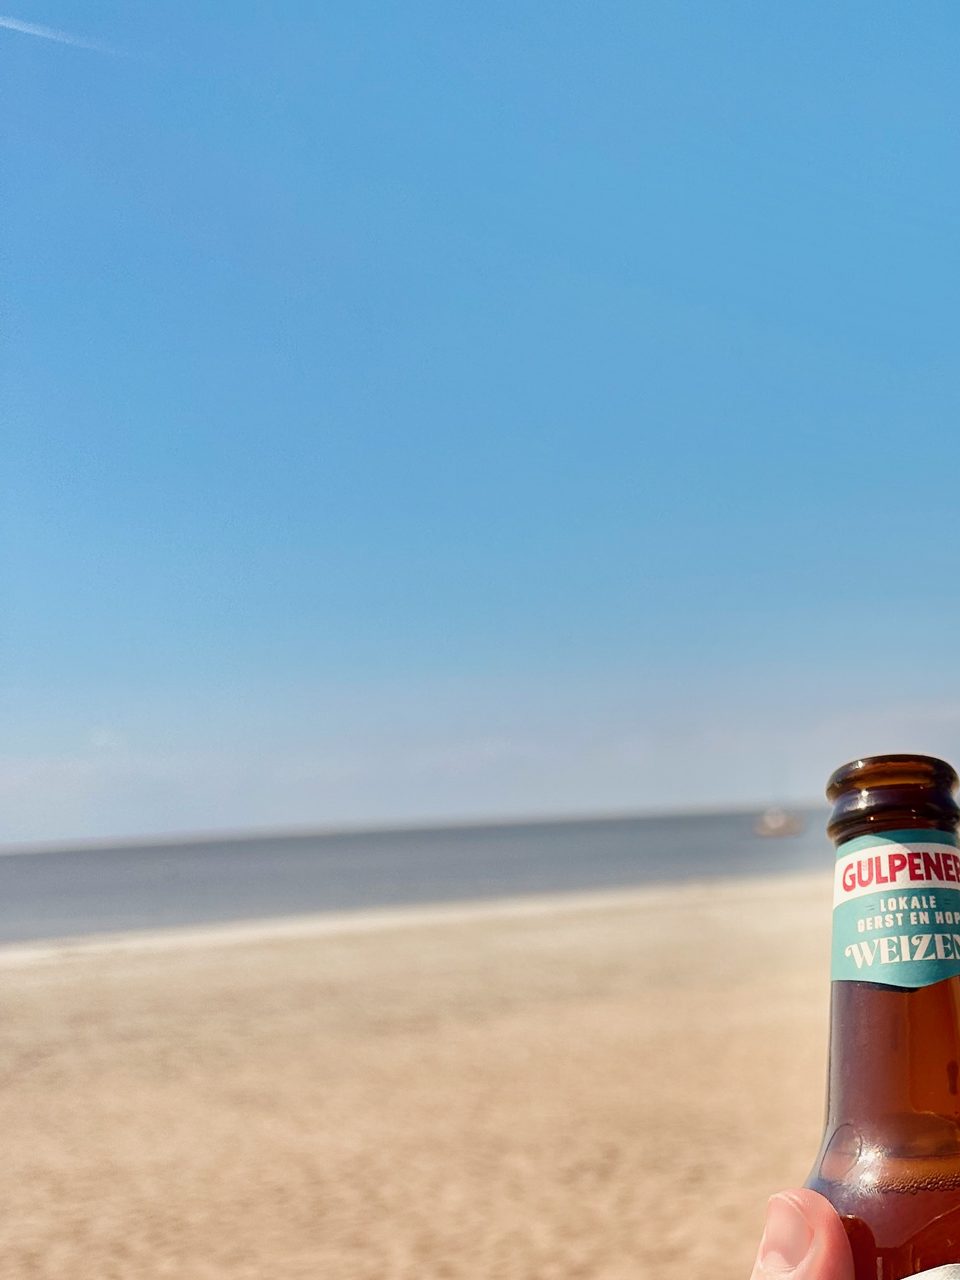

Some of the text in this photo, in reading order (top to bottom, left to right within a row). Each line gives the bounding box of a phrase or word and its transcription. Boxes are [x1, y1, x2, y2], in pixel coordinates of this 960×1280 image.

[880, 896, 936, 912] LOKALE
[910, 911, 929, 925] EN
[935, 911, 960, 925] HOP
